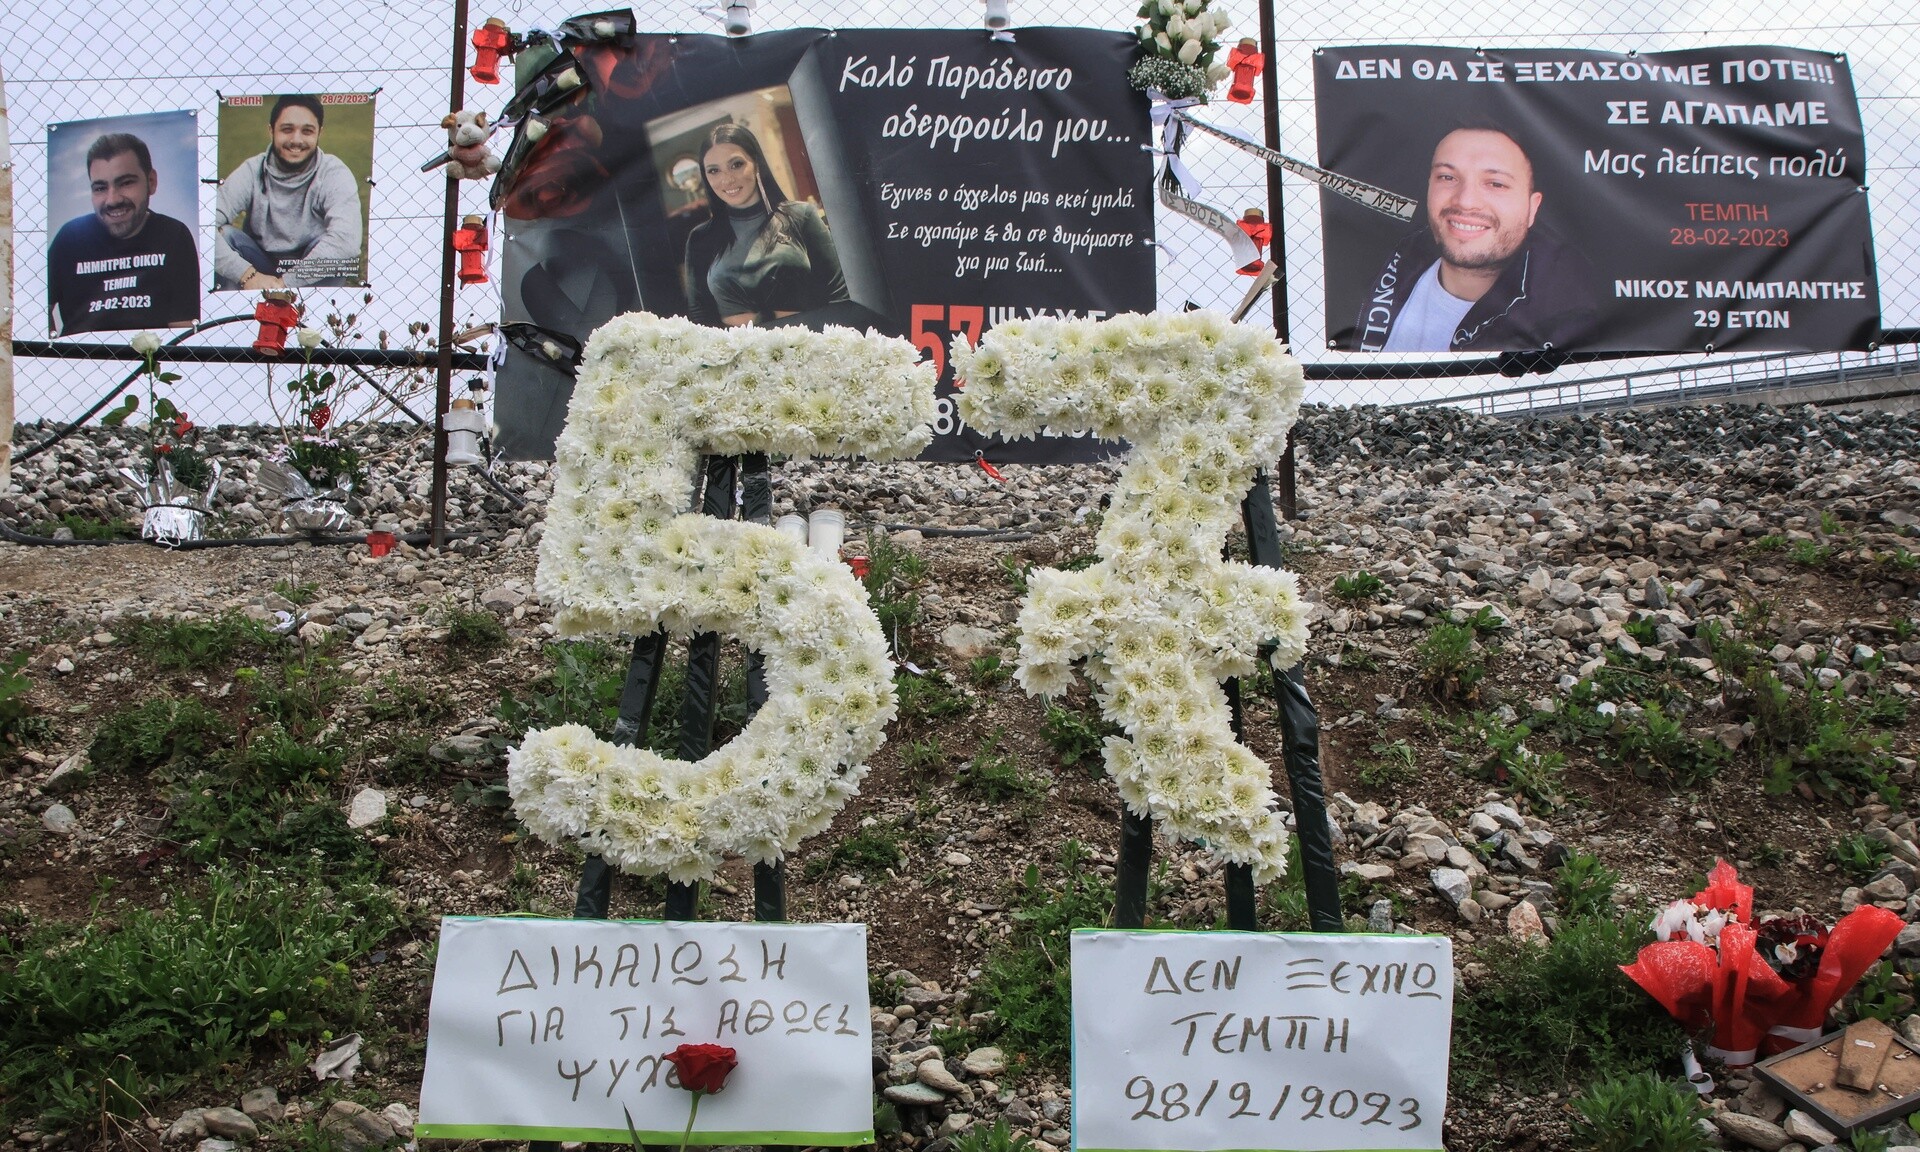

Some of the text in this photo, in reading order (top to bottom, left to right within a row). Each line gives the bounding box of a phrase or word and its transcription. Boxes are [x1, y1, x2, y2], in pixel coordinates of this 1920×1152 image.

[839, 55, 1073, 99] Καλό Παράδεισο
[1335, 59, 1834, 86] ΔΕΝ ΘΑ ΣΕ ΞΕΧΑΣΟΥΜΕ ΠΟΤΕ!!!
[228, 96, 263, 106] ΤΕΜΠΗ
[321, 94, 370, 104] 28/2/2023
[1606, 100, 1829, 127] ΣΕ ΑΓΑΠΑΜΕ
[882, 103, 1131, 158] αδερφούλα μου...
[1584, 146, 1847, 180] Μας λείπεις πολύ
[881, 183, 932, 210] Έγινες
[938, 189, 948, 202] ο
[953, 184, 1017, 211] άγγελος
[1022, 191, 1050, 212] μας
[1055, 189, 1089, 209] εκεί
[1685, 203, 1769, 222] ΤΕΜΠΗ
[887, 221, 1134, 256] Σε αγαπάμε & θα σε θυμόμαστε
[1669, 228, 1790, 248] 28-02-2023
[76, 253, 166, 275] ΔΗΜΗΤΡΗΣ ΟΙΚΟΥ
[955, 255, 980, 278] για
[985, 258, 1010, 279] μια
[103, 275, 138, 292] ΤΕΜΠΗ
[1614, 279, 1866, 299] ΝΙΚΟΣ ΝΑΛΜΠΑΝΤΗΣ
[88, 295, 152, 313] 28-02-2023
[1693, 310, 1790, 329] 29 ΕΤΩΝ
[497, 939, 787, 996] ΔΙΚΑΙΩΣΗ
[1144, 955, 1442, 1000] ΔΕΝ ΞΕΧΝΩ
[497, 998, 860, 1047] ΓΙΑ ΤΙΣ ΑΘΩΕΣ
[1171, 1011, 1349, 1056] ΤΕΜΠΗ
[1124, 1075, 1423, 1131] 28/2/2023
